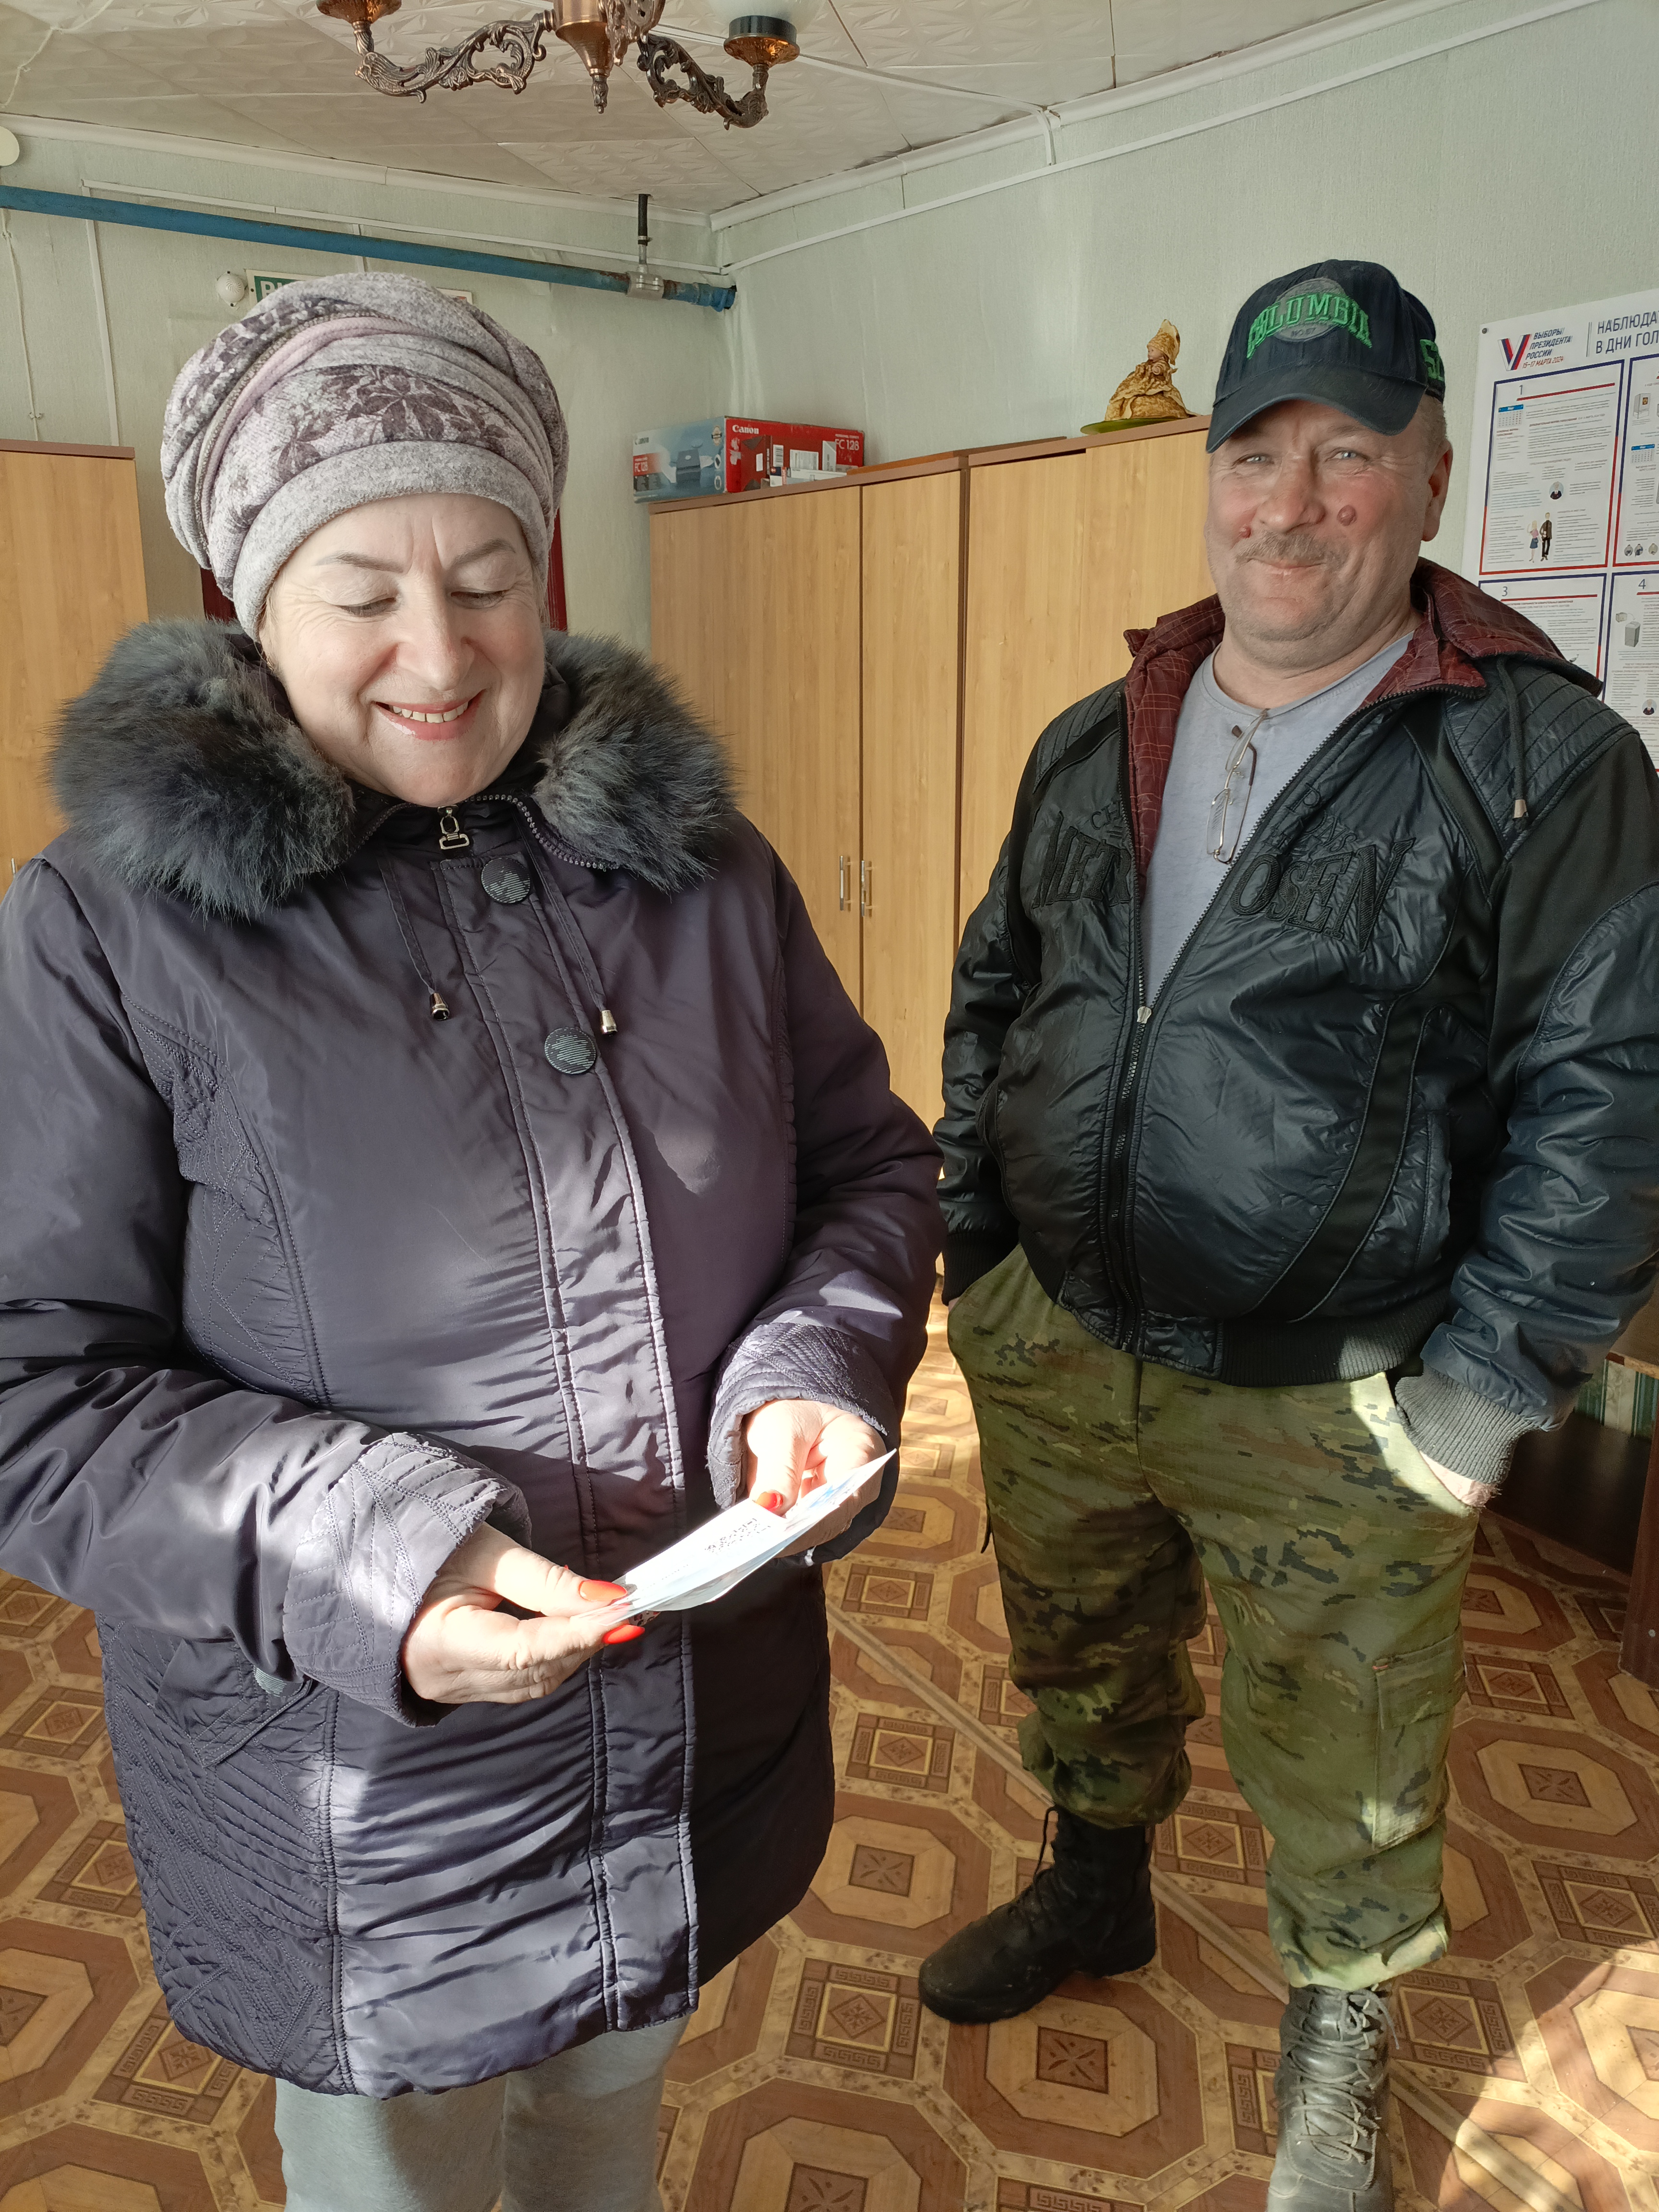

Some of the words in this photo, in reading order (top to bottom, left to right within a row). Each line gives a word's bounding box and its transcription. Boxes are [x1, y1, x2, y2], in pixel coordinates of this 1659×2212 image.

[1598, 310, 1659, 335] НАБЛЮДА
[1534, 327, 1563, 340] ВЫБОРЫ
[1529, 336, 1572, 350] ПРЕЗИДЕНТА
[1596, 340, 1602, 354] В
[1605, 335, 1632, 354] ДНИ
[1526, 349, 1553, 360] РОССИИ
[1519, 385, 1523, 395] 1
[732, 424, 759, 434] Canon
[835, 439, 845, 449] FC
[846, 439, 860, 450] 128
[1638, 578, 1646, 590] 4
[1502, 586, 1508, 597] 3
